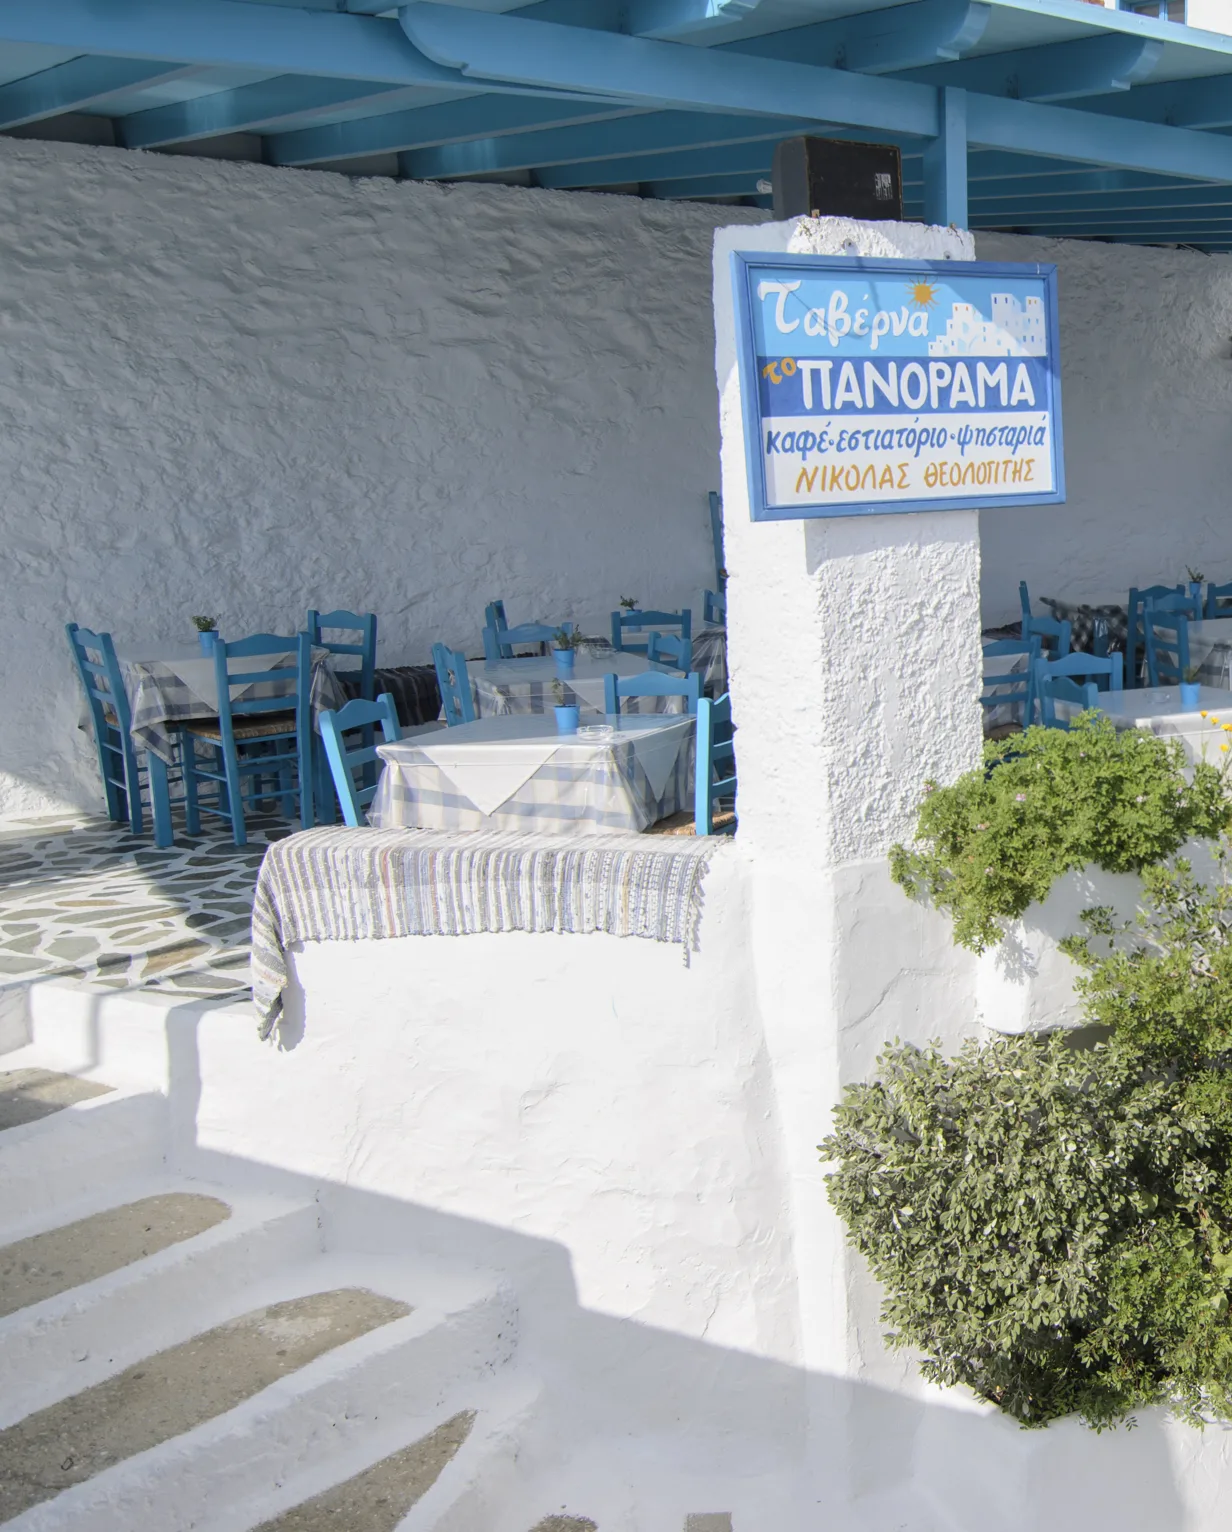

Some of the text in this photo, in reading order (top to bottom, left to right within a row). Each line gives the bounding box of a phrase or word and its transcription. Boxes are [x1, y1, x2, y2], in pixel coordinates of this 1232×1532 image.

[757, 280, 929, 350] Ταβέρνα
[763, 357, 1036, 410] το ΠΑΝΟΡΑΜΑ
[795, 458, 1035, 493] ΝΙΚΟΛΑΣ ΘΕΟΛΟΓΙΤΗΣ
